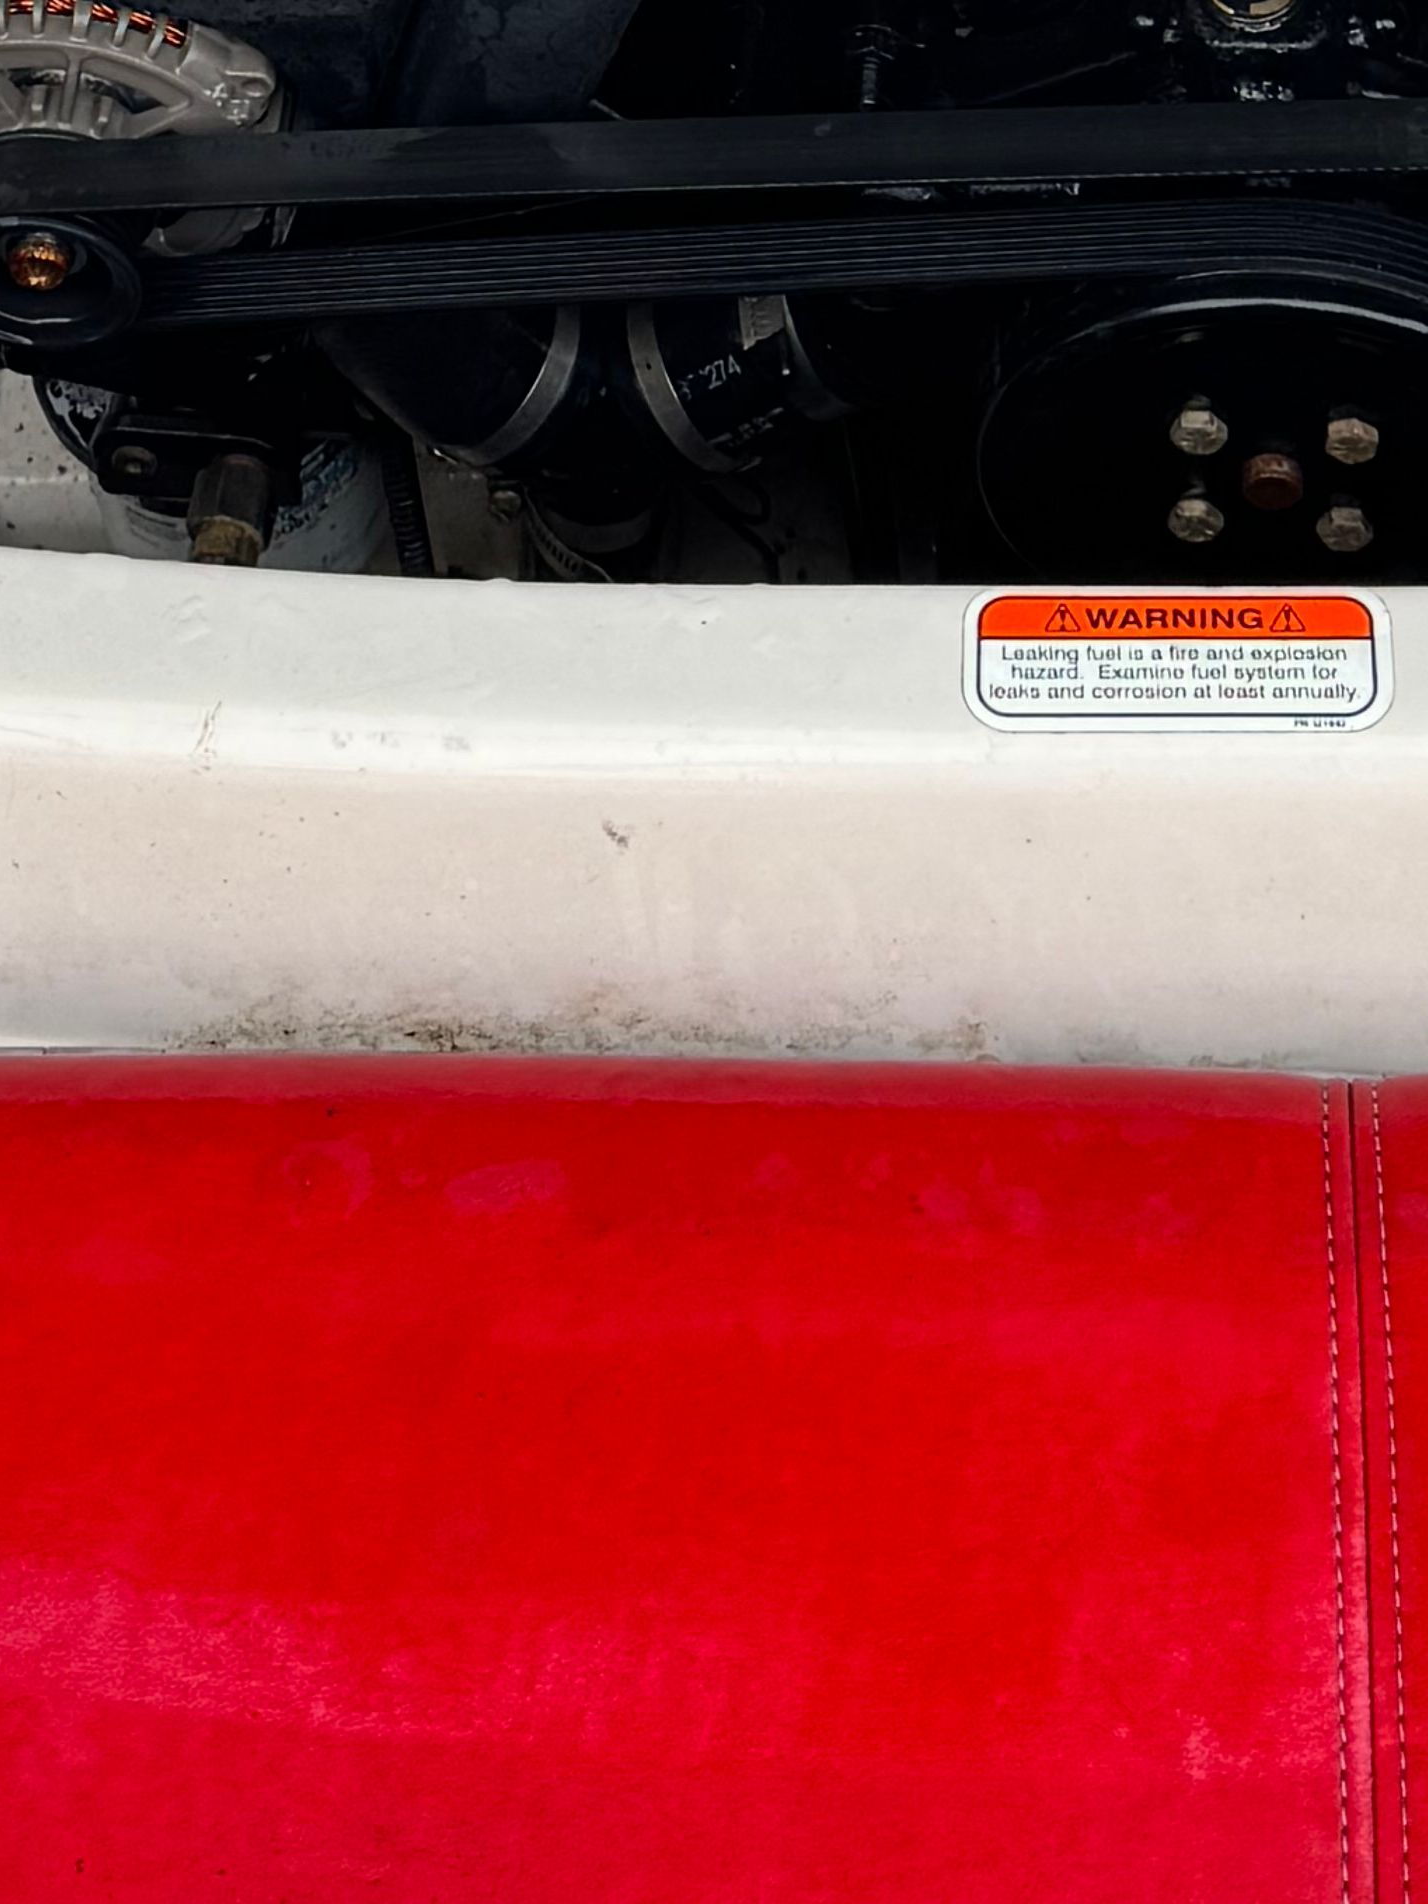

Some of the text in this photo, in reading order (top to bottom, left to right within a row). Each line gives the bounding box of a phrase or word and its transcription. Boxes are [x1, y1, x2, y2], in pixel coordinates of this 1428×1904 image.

[1085, 608, 1264, 630] WARNING
[1001, 645, 1348, 665] Leaking fuel is a fire and explosion
[1098, 664, 1185, 680] Examine
[1191, 664, 1227, 680] fuel
[1234, 665, 1305, 683] system
[1312, 664, 1338, 680] for
[989, 683, 1041, 700] leaks
[1047, 684, 1085, 700] and
[1091, 684, 1187, 700] corrosion
[1194, 684, 1212, 700] at
[1218, 684, 1265, 700] least
